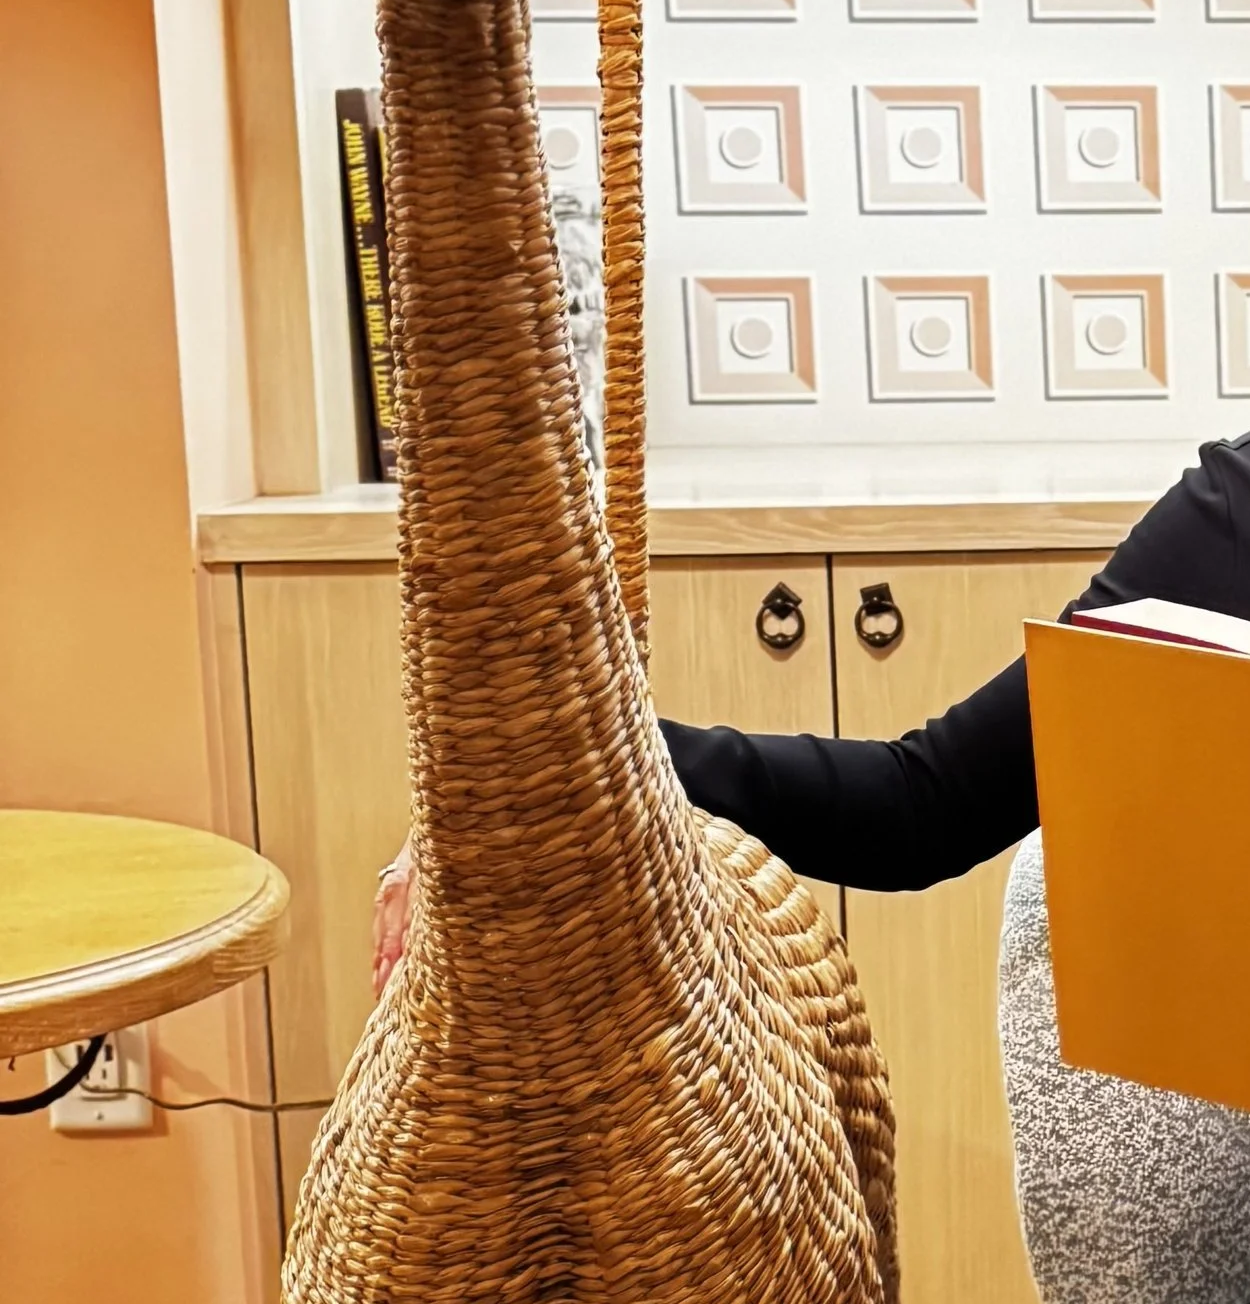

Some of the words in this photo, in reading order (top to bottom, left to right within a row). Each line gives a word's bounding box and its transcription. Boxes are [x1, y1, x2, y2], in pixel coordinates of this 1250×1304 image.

[342, 119, 365, 164] JOHN
[360, 248, 383, 300] THERE
[366, 304, 385, 347] RODE
[371, 350, 386, 361] A
